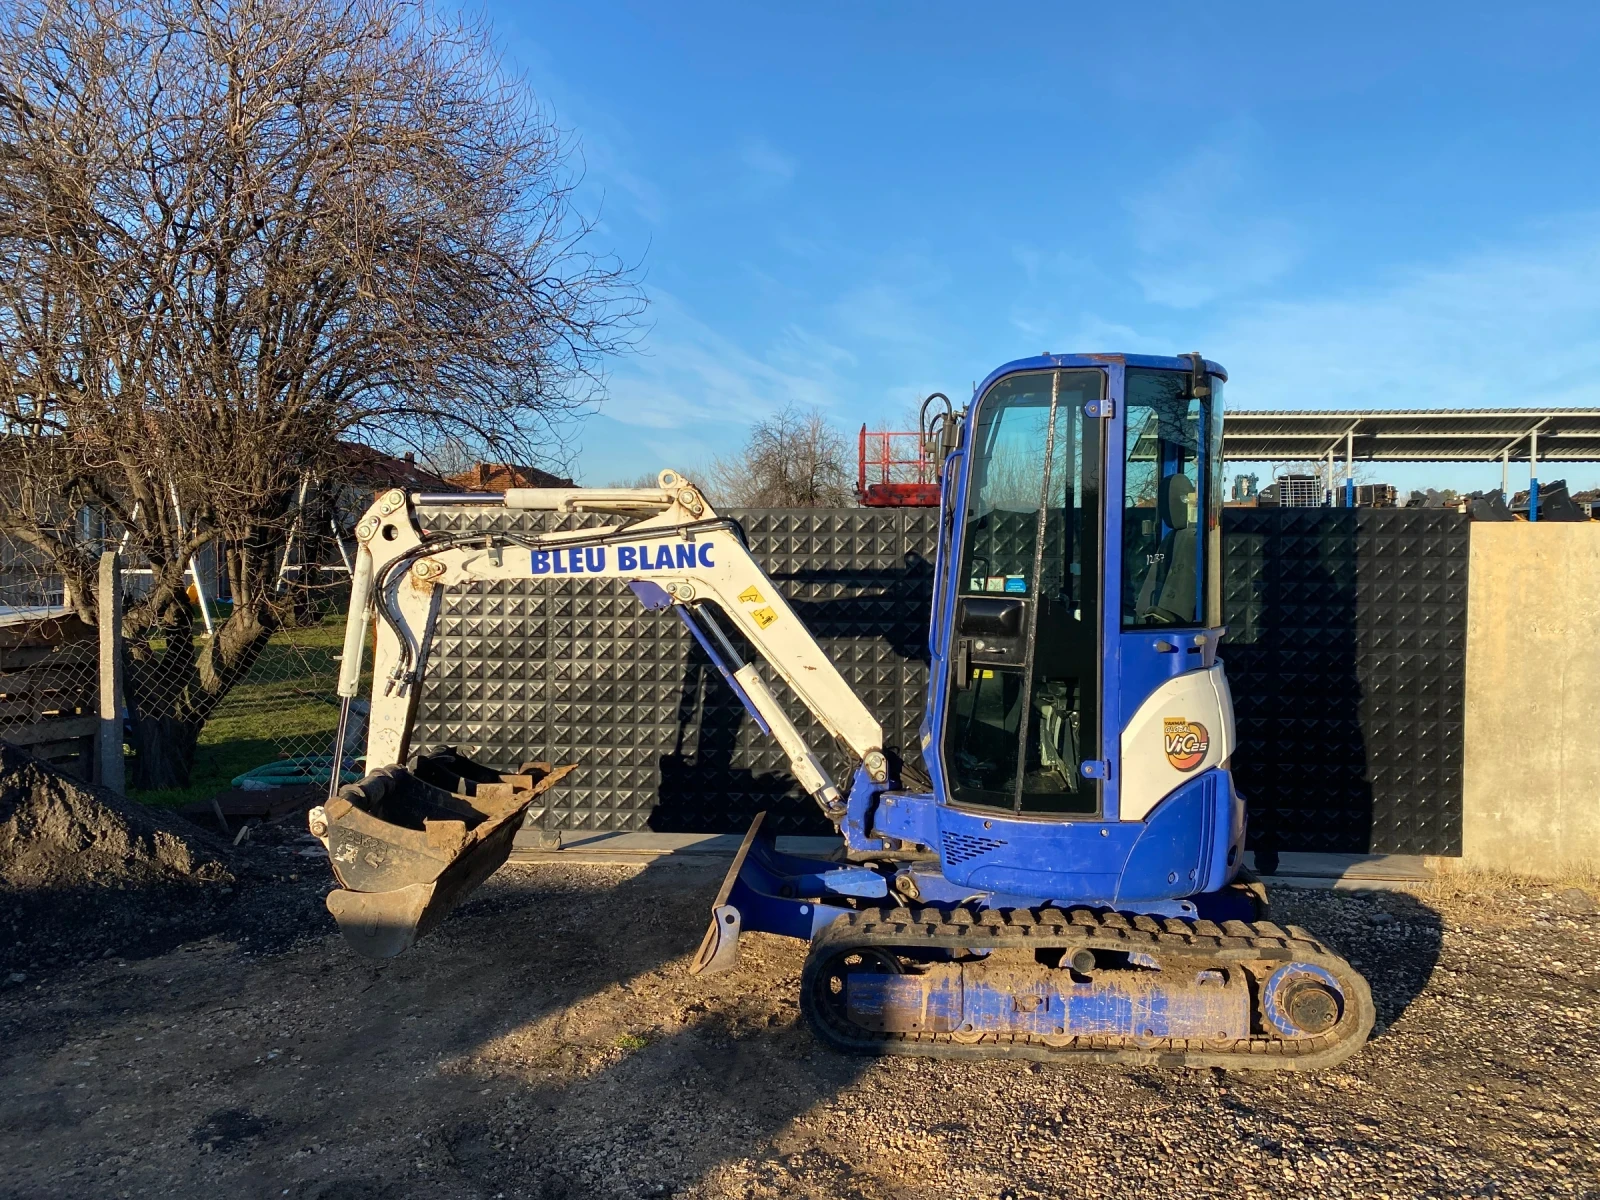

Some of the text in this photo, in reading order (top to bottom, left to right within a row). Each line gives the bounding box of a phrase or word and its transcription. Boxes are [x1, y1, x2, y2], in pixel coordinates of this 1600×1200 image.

[531, 542, 715, 574] BLEU BLANC
[1165, 725, 1191, 733] GLOBAL
